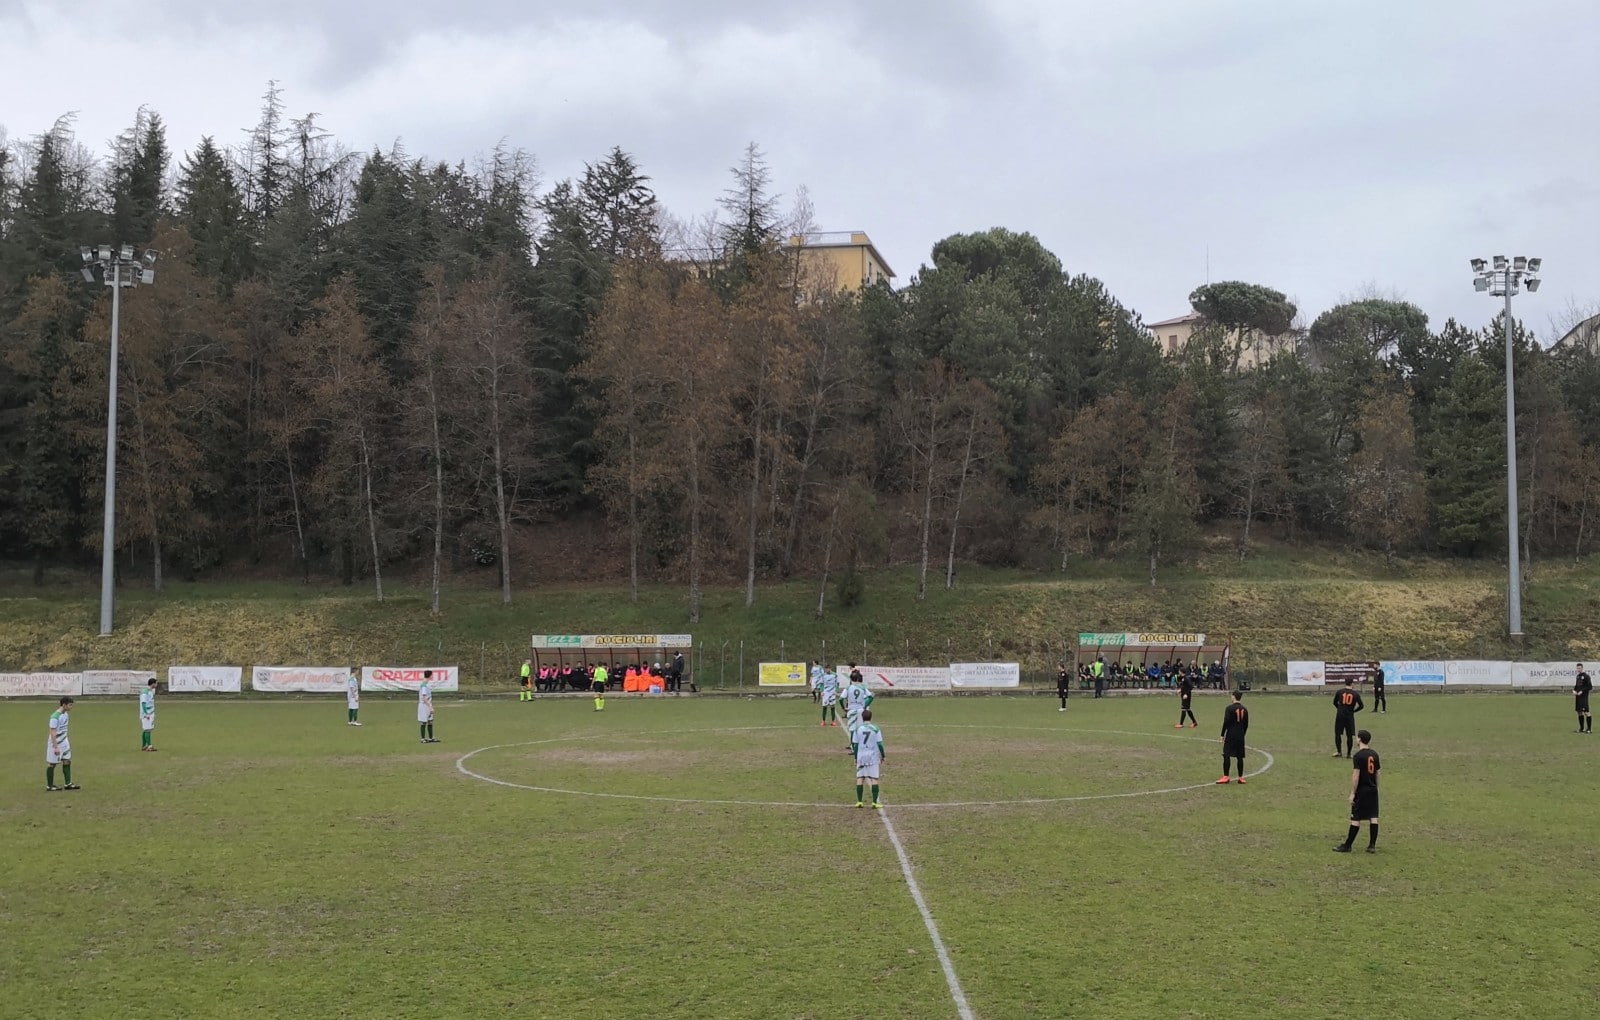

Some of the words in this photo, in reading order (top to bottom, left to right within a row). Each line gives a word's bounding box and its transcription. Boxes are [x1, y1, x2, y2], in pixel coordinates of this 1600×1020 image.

[595, 636, 657, 644] NOCCIOLINI
[1139, 633, 1198, 642] NOCCIOLINI
[171, 675, 186, 686] La
[192, 675, 223, 686] Nena
[853, 688, 860, 699] 9
[1341, 692, 1353, 705] 10
[1235, 708, 1245, 722] 11
[862, 731, 871, 745] 7
[1367, 755, 1375, 774] 6
